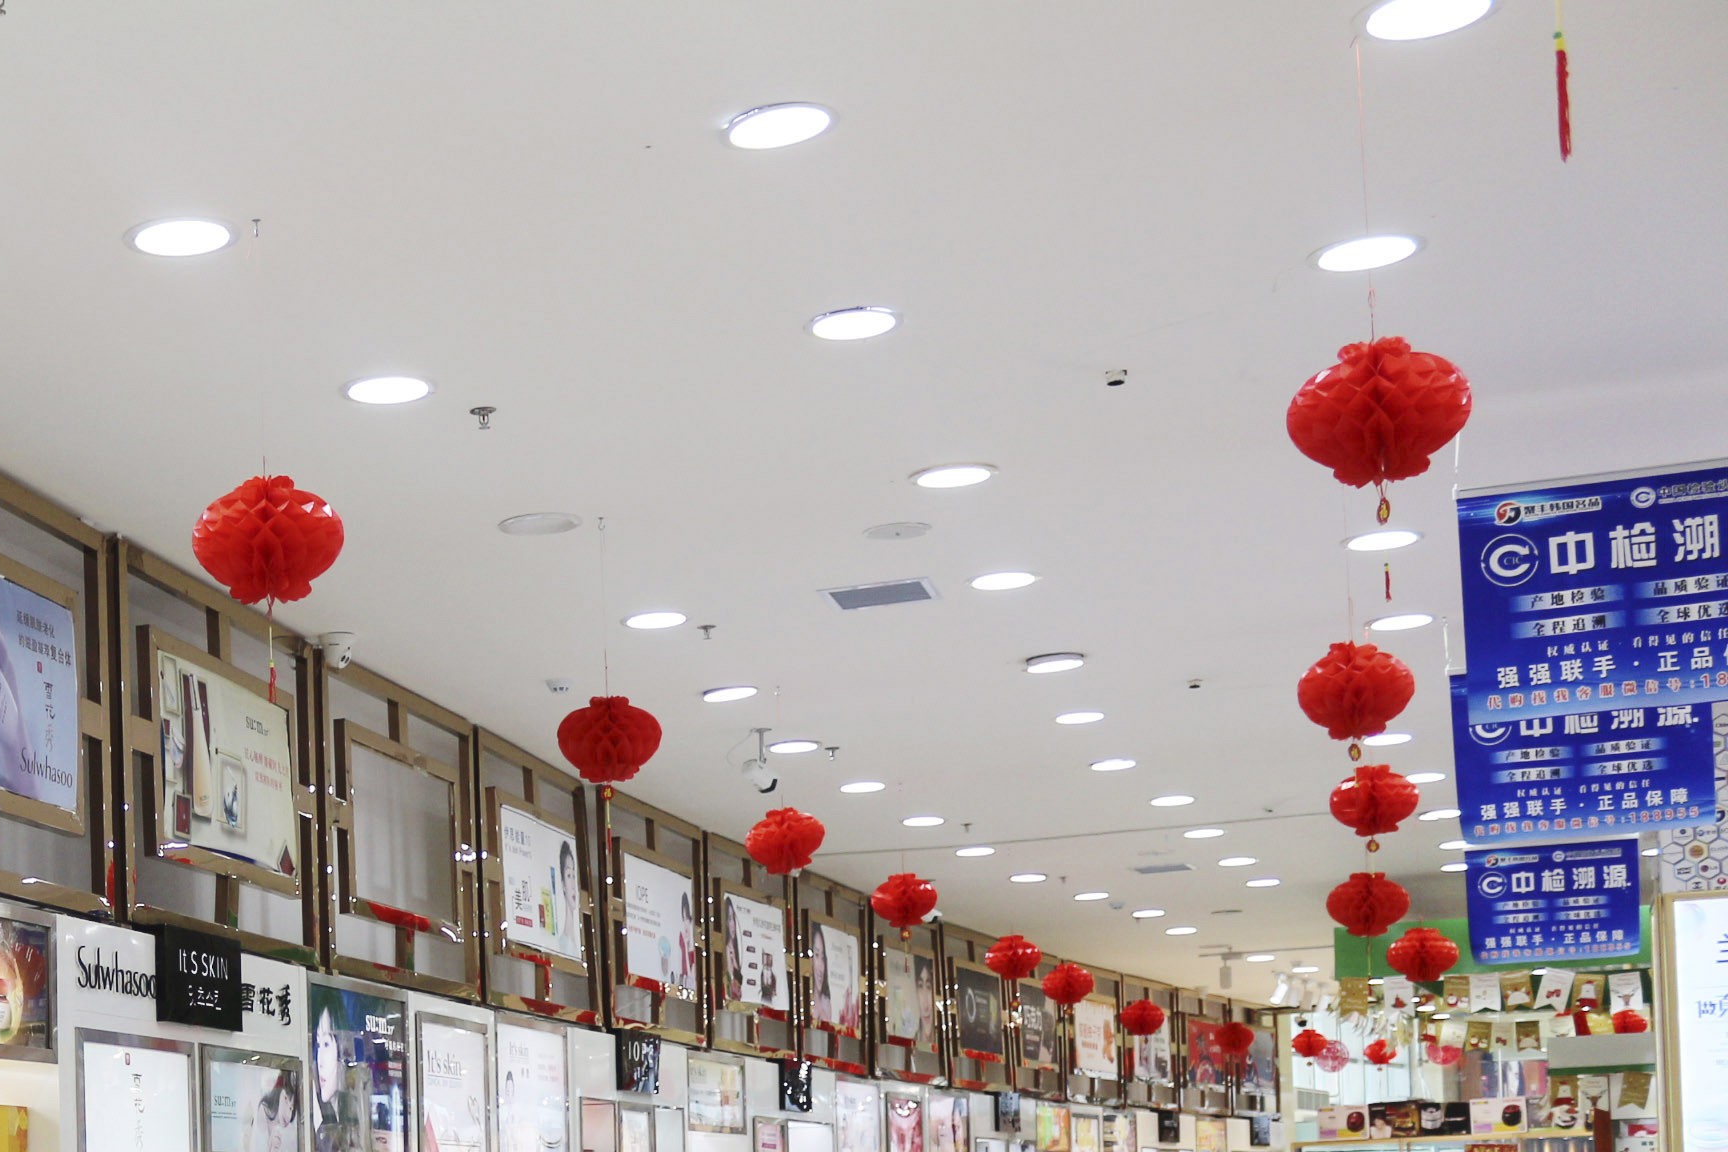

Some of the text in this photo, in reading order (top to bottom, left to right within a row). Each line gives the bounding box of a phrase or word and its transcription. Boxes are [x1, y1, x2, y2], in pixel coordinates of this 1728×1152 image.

[1548, 514, 1721, 575] 中检溯
[18, 746, 73, 789] Sulwhasoo
[76, 945, 157, 1000] Sulwhasoo
[201, 953, 229, 981] SKIN
[240, 982, 292, 1026] 雪花秀
[426, 1049, 462, 1077] It's skin
